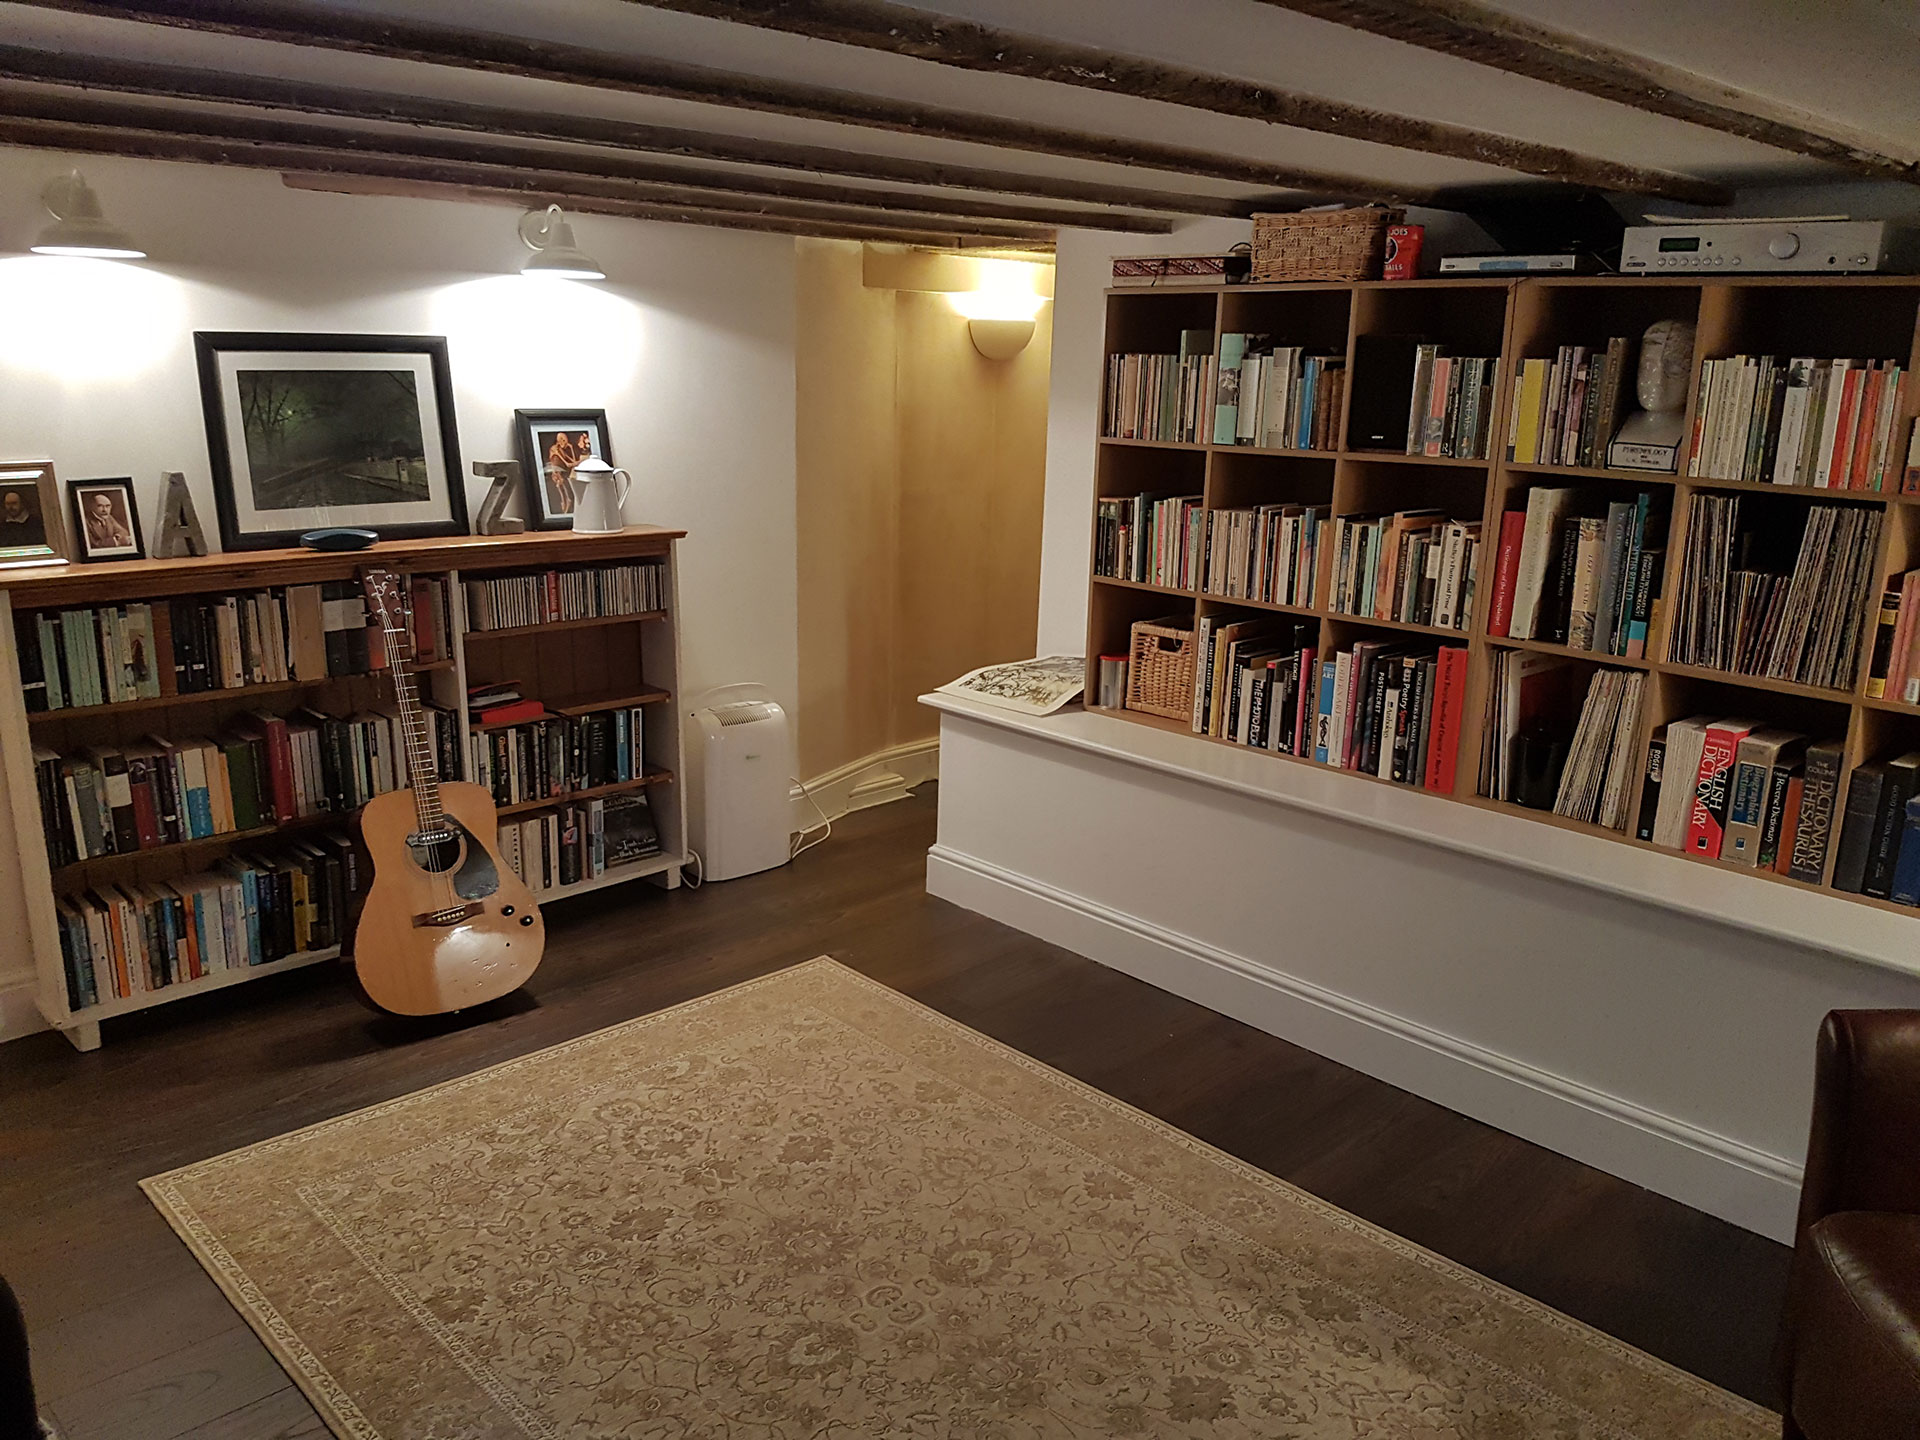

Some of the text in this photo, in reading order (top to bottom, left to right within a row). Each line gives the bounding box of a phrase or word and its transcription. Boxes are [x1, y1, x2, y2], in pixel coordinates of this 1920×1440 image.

[152, 471, 208, 559] A
[473, 460, 525, 536] Z
[1501, 545, 1512, 574] Dictionary
[1375, 671, 1385, 713] POSTSECRET
[1383, 708, 1393, 739] Anthology
[1399, 683, 1411, 709] Poetry
[1692, 745, 1718, 829] DICTIONARY
[1709, 747, 1730, 810] ENGLISH
[1734, 765, 1753, 810] Dictionary
[1747, 767, 1765, 825] Biographical
[1765, 777, 1785, 843] Reverse Dictionary
[1792, 784, 1819, 866] THESAURUS
[1807, 780, 1834, 869] DICTIONARY
